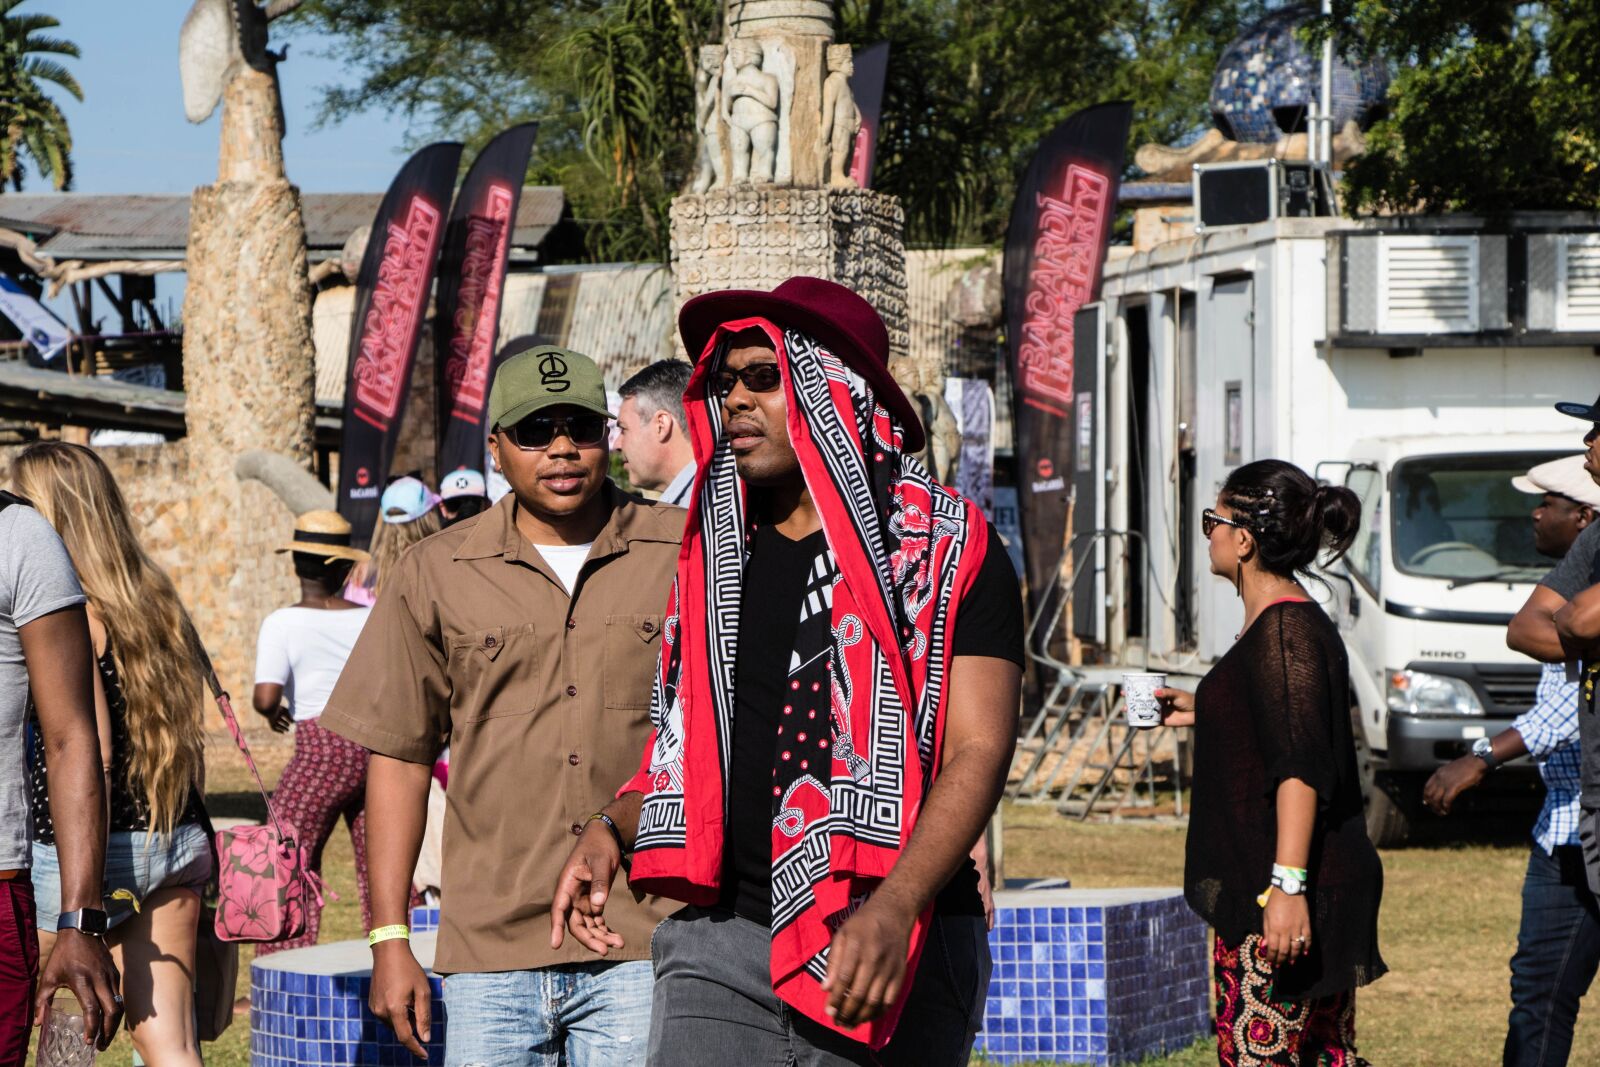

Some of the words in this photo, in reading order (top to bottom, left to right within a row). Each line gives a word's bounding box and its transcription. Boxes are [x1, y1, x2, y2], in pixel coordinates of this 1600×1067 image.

[1065, 178, 1101, 281] PARTY
[374, 303, 409, 398] HOUSE
[396, 209, 432, 306] PARTY
[1420, 650, 1466, 659] HINO
